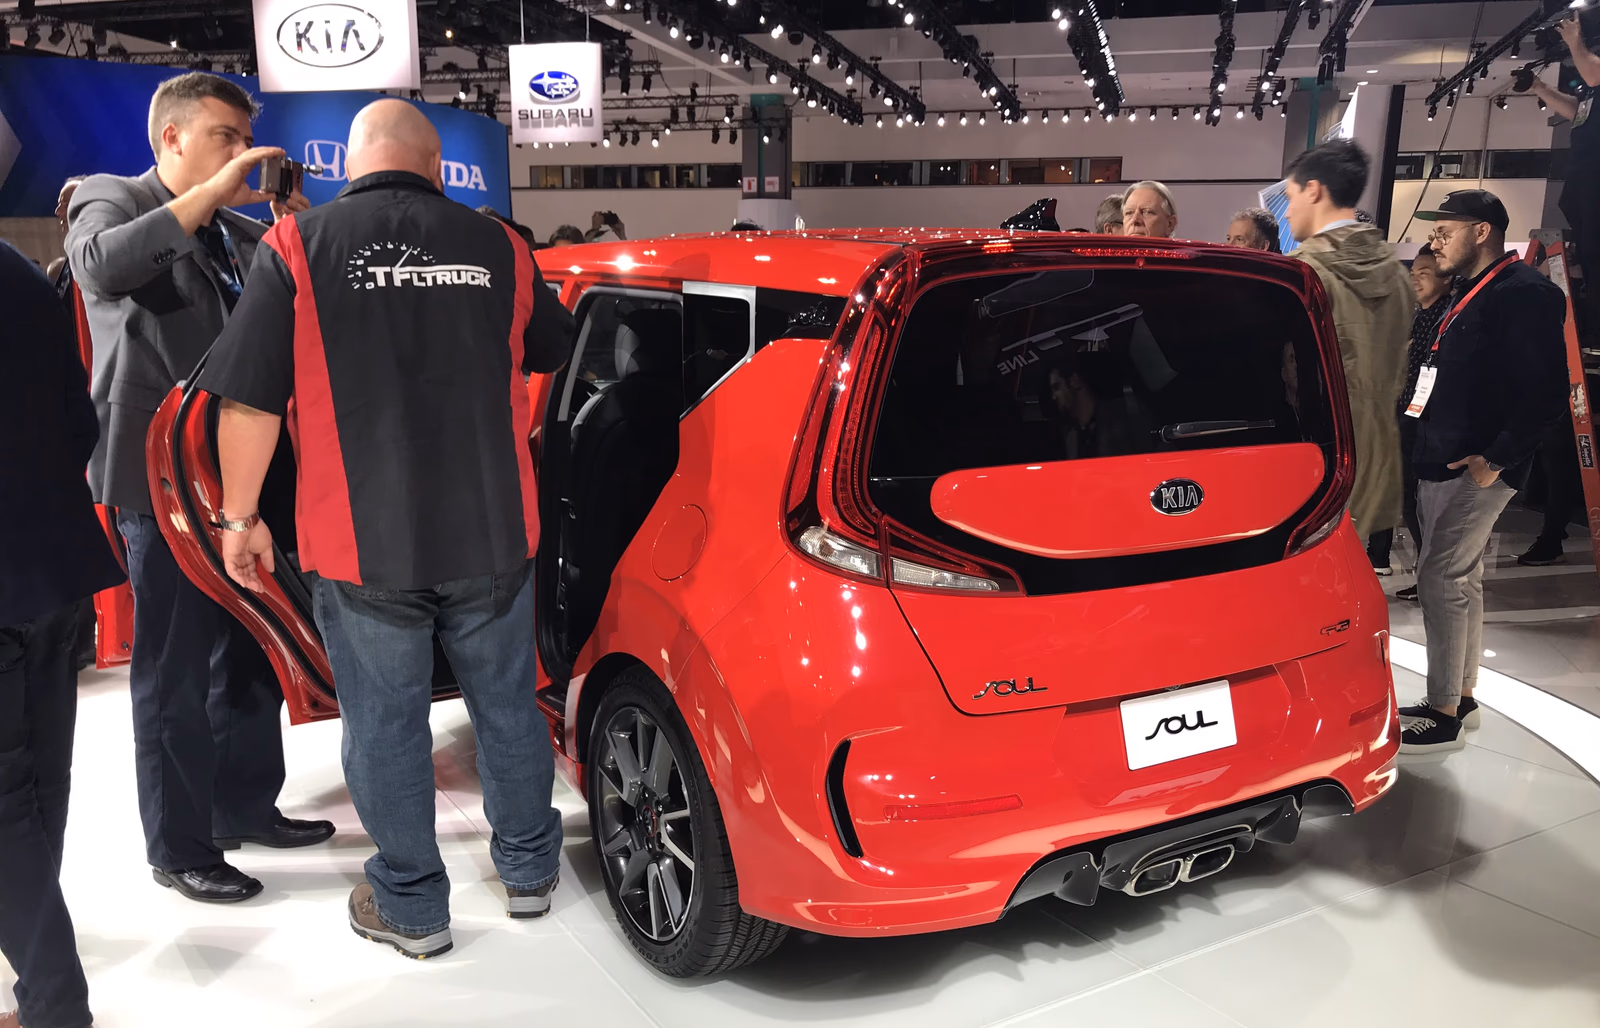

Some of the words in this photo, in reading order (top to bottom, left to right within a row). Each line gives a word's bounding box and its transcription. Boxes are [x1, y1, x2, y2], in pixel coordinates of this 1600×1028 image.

[295, 19, 366, 54] KIA
[518, 108, 593, 121] SUBARU
[1160, 485, 1199, 509] KIA
[1145, 710, 1218, 741] SOUL
